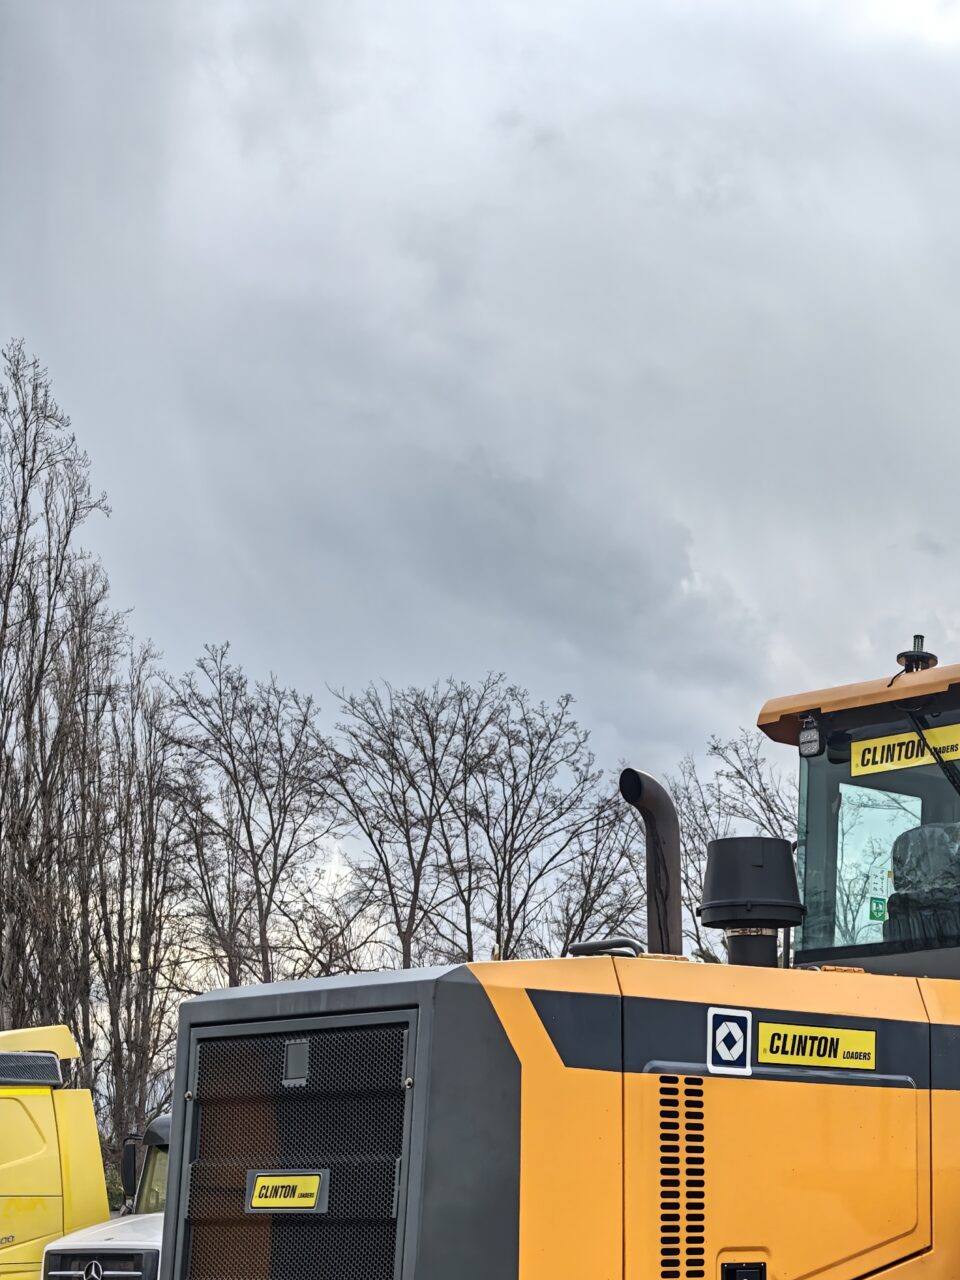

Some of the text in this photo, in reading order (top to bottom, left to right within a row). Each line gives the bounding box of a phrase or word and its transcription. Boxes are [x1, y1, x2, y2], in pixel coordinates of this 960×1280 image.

[860, 738, 959, 767] CLINTON ADERS
[769, 1032, 872, 1061] CLINTON LOADERS
[258, 1184, 298, 1199] CLINTON
